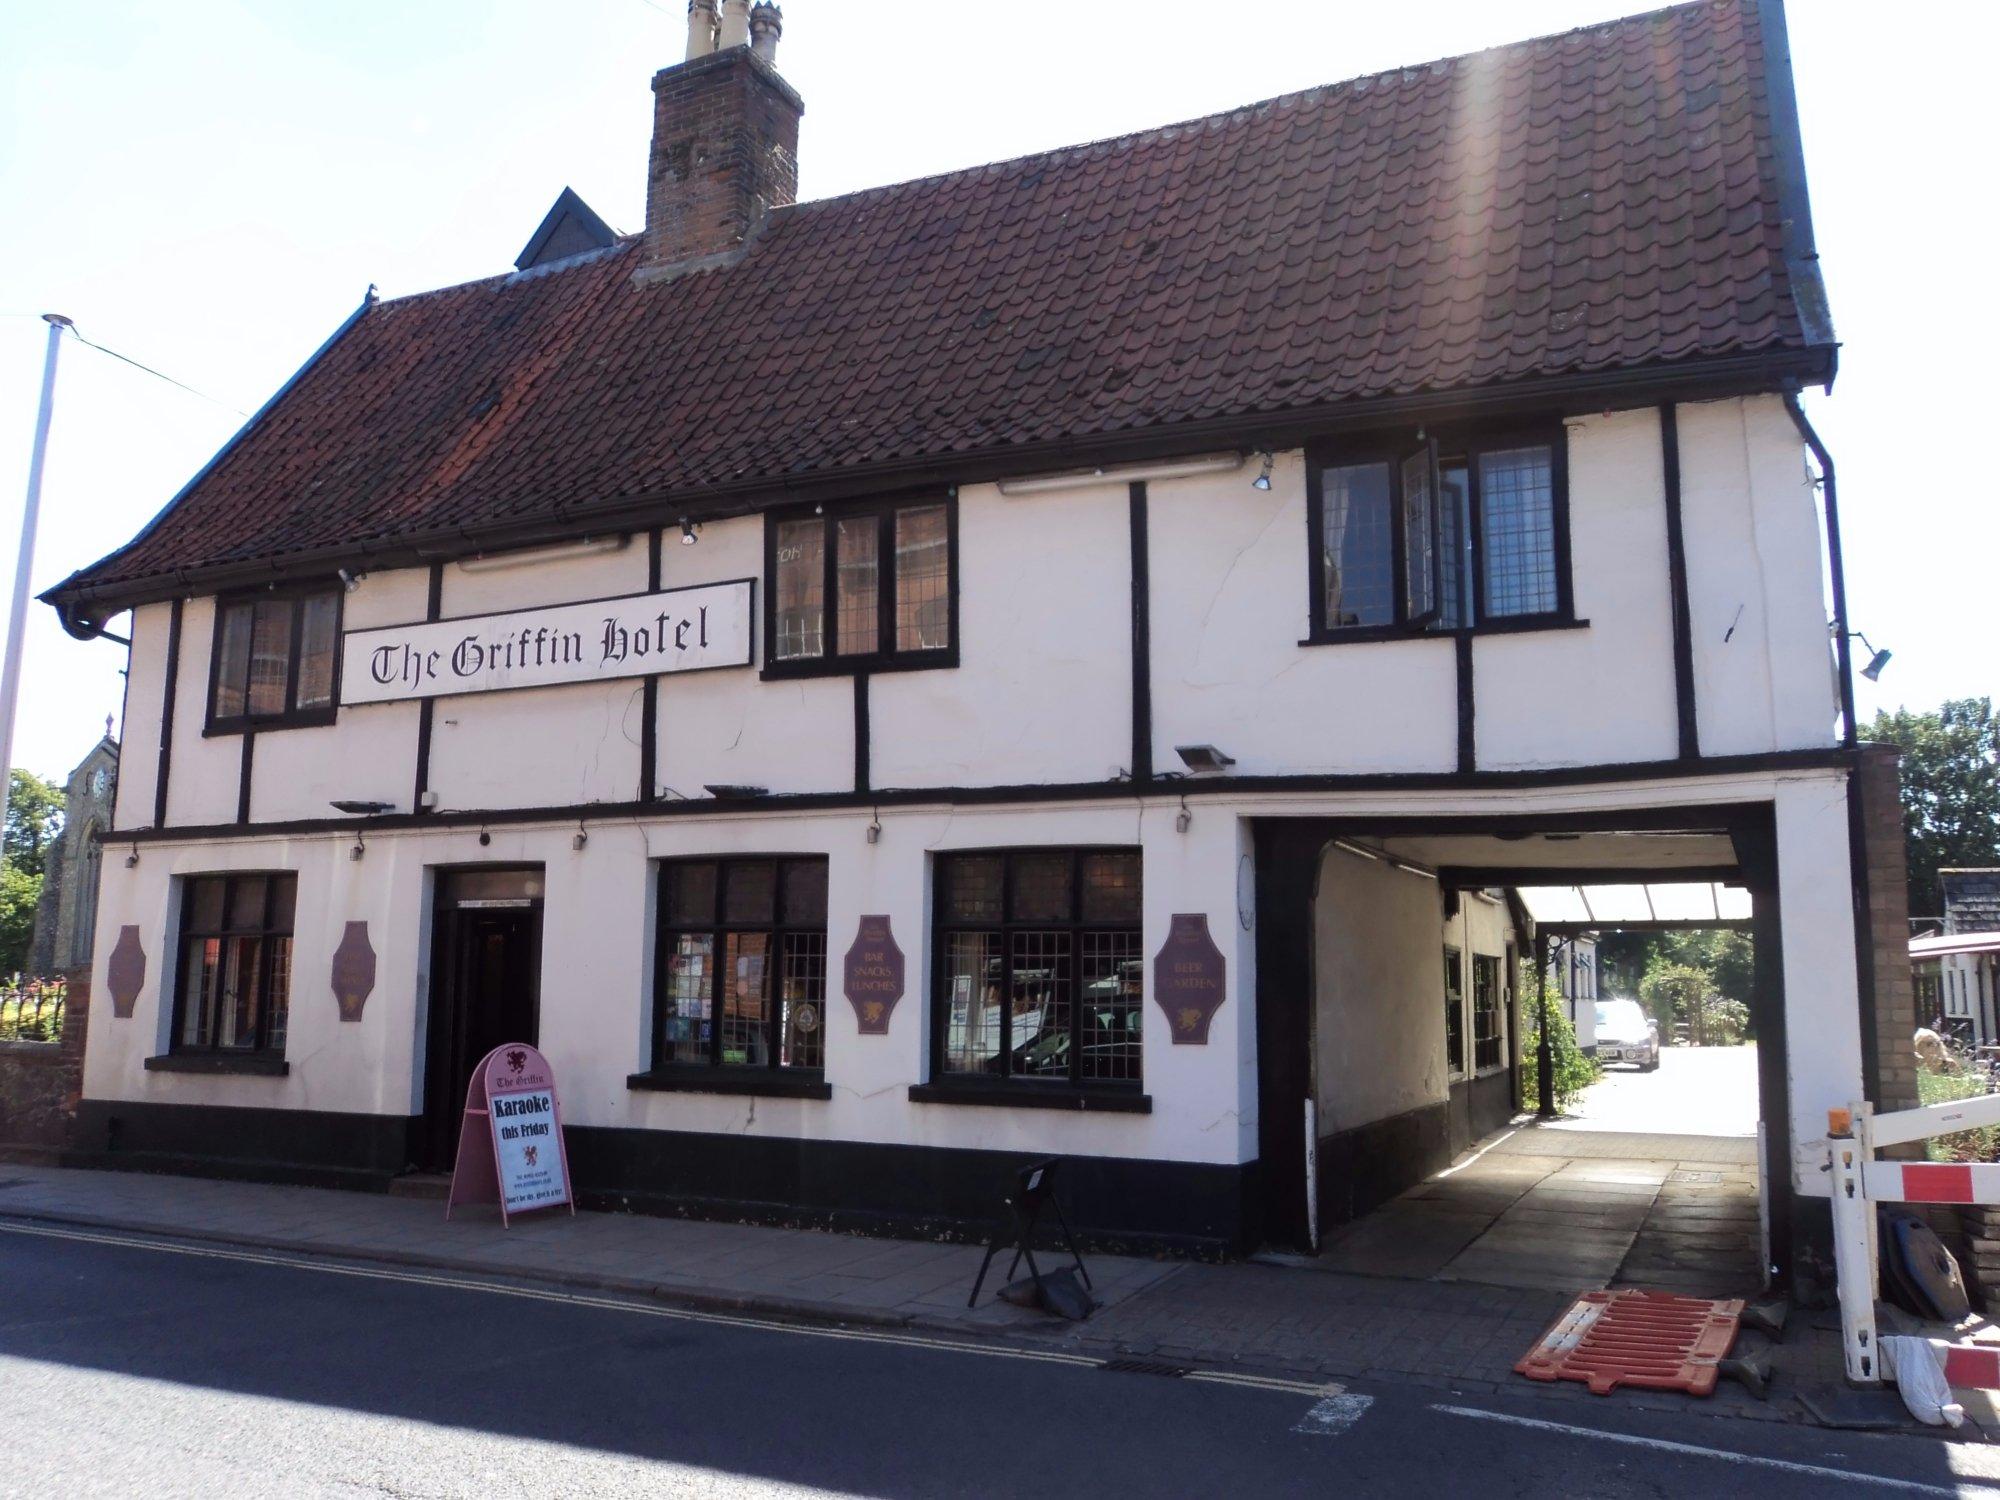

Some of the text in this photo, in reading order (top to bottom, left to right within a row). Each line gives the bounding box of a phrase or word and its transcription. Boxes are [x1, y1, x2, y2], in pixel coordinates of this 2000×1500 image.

[371, 605, 709, 691] The Griffin Hotel
[864, 952, 884, 962] BAR
[1168, 977, 1217, 989] ARDEN
[496, 1074, 545, 1089] The Griffin
[494, 1096, 550, 1118] Karaoke
[501, 1123, 549, 1140] this Friday
